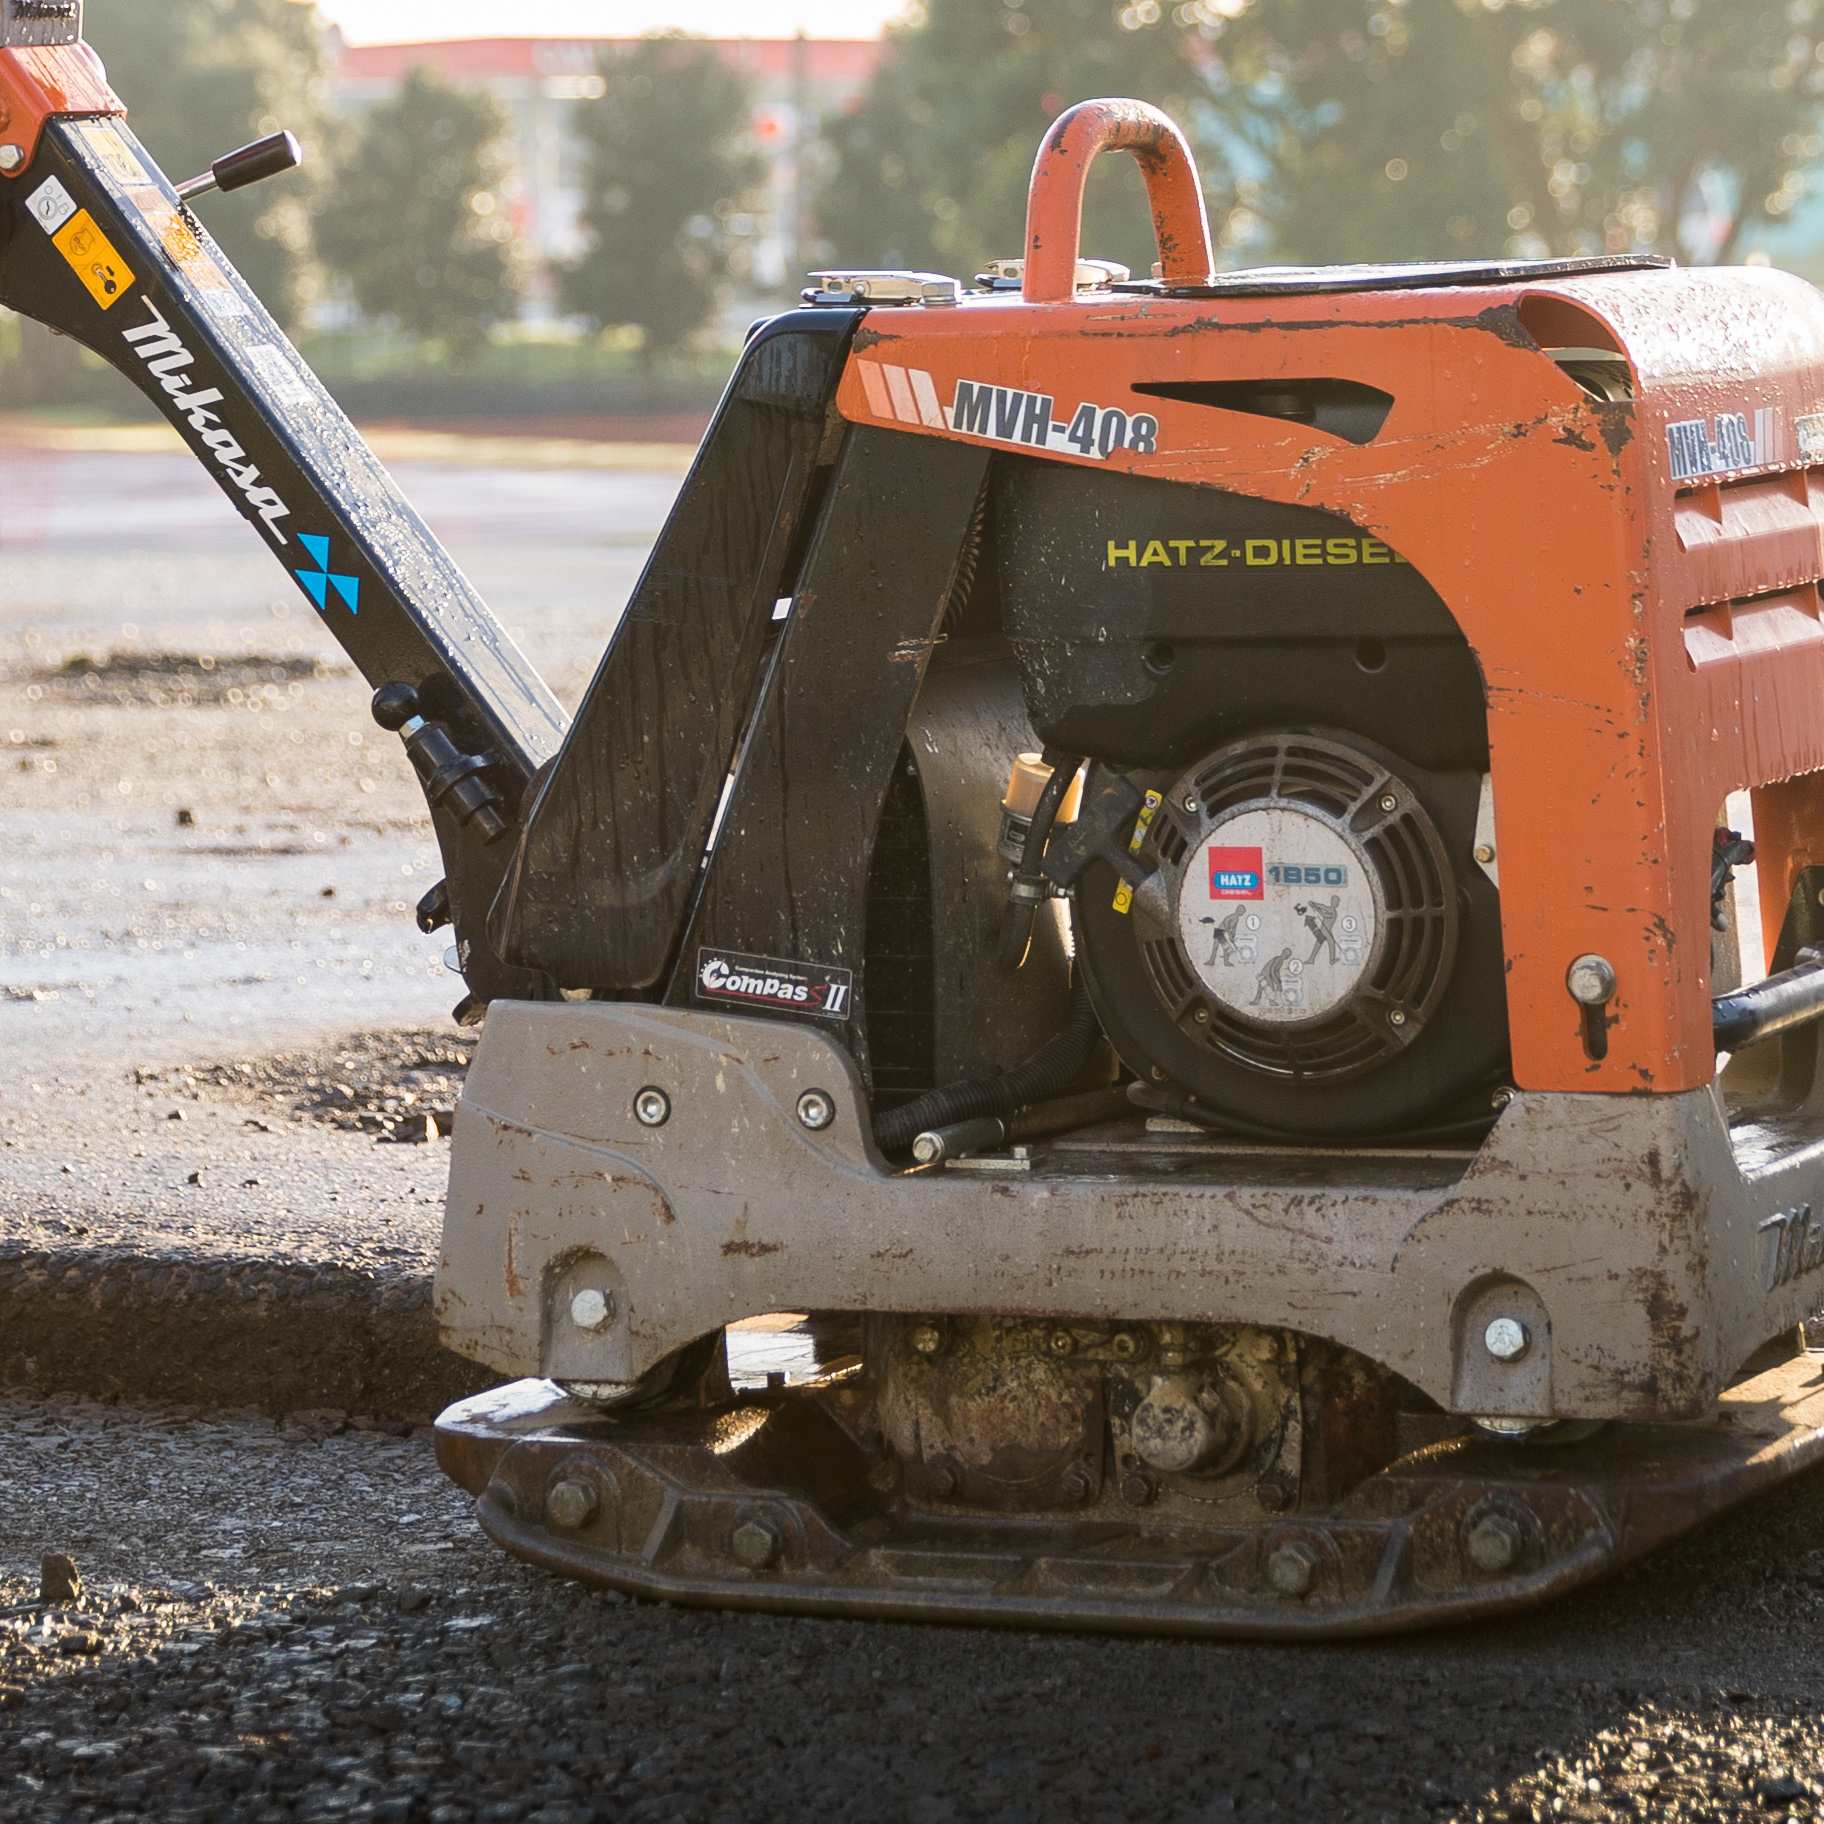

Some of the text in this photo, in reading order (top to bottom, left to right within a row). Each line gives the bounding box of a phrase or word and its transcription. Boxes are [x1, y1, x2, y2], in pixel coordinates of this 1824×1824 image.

[122, 294, 291, 545] Mikasa
[953, 380, 1158, 454] MVH-408
[1220, 874, 1251, 886] HATZ
